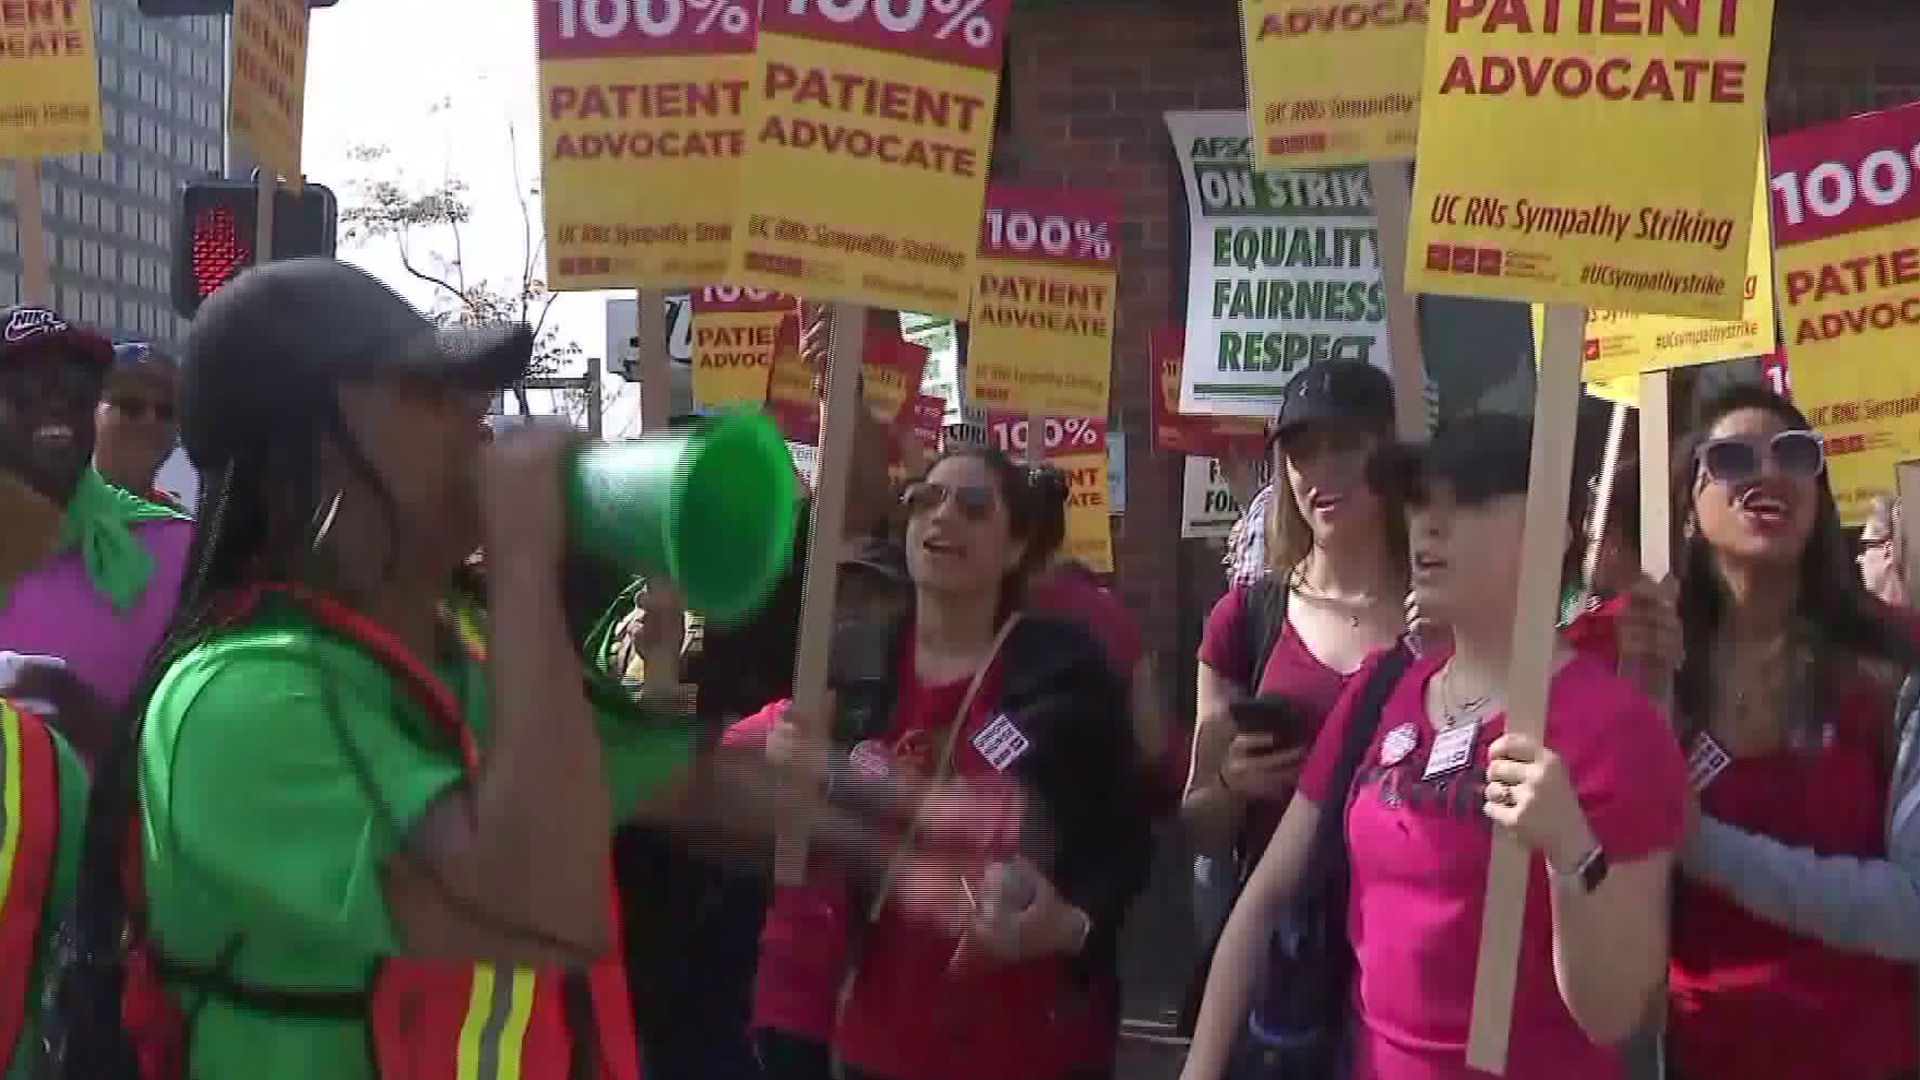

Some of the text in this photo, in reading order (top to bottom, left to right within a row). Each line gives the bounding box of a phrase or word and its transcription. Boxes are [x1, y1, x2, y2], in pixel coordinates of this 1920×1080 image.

[558, 0, 749, 38] 100%
[789, 0, 993, 47] 0%
[1445, 0, 1738, 37] PATIENT
[548, 80, 749, 120] PATIENT
[765, 62, 985, 133] PATIENT
[1439, 56, 1747, 104] ADVOCATE
[553, 130, 747, 160] ADVOCATE
[758, 116, 976, 178] ADVOCATE
[1202, 170, 1255, 207] ON
[985, 208, 1112, 261] 100%
[1431, 194, 1733, 250] UC RNs Sympathy Striking
[980, 275, 1108, 312] PATIENT
[1581, 264, 1726, 295] #UCsympathystrike
[1787, 249, 1920, 306] PATIE
[1212, 278, 1387, 322] FAIRNESS
[697, 327, 773, 346] PATIE
[978, 308, 1108, 338] ADVOCATE
[1795, 299, 1920, 345] ADVOC
[700, 353, 768, 368] ADVOC
